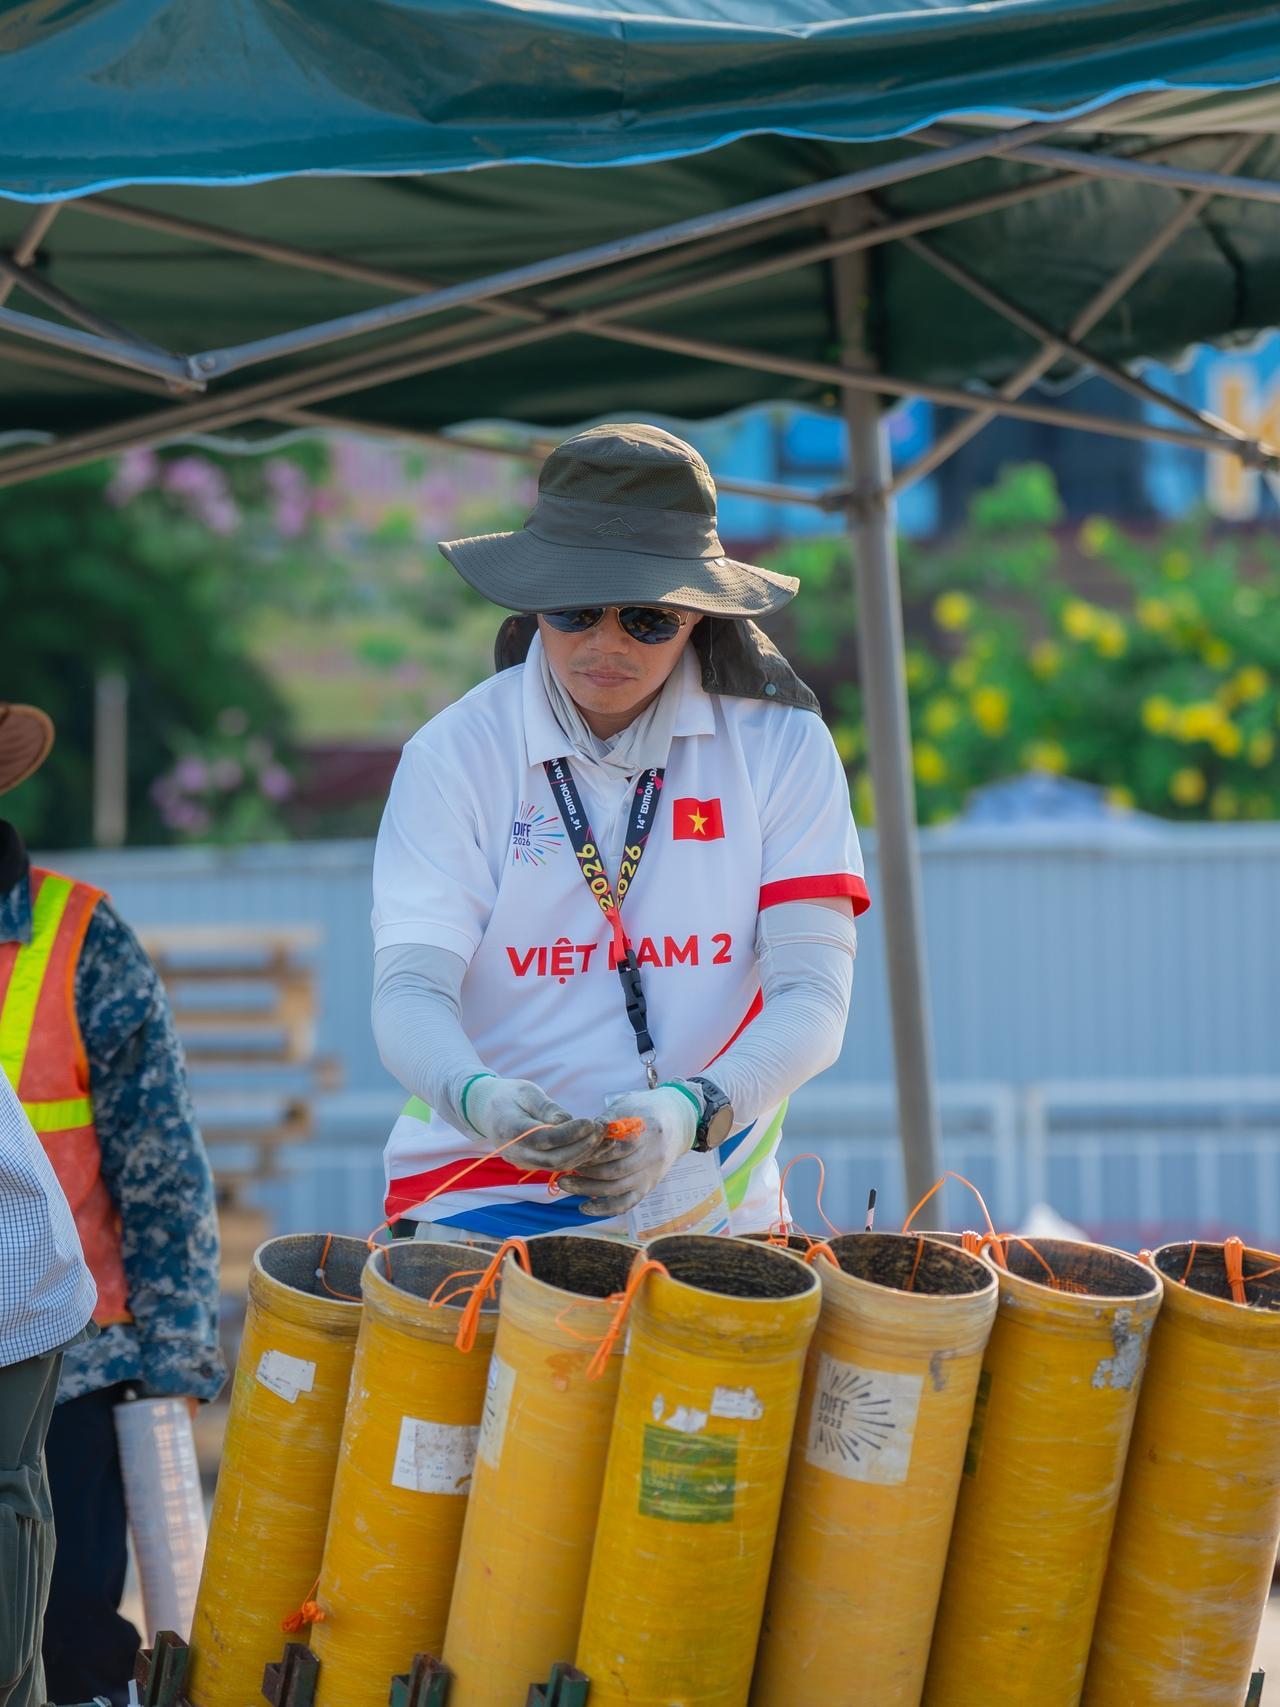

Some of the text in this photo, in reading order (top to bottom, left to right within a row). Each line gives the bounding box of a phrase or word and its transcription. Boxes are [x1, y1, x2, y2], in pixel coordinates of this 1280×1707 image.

[560, 783, 577, 815] EDITION
[640, 782, 654, 815] EDITION
[513, 821, 532, 837] DIFF
[513, 836, 531, 846] 2026
[576, 844, 614, 911] 2026
[506, 937, 598, 984] VIỆT
[711, 933, 732, 965] 2
[820, 1391, 850, 1418] DIFF
